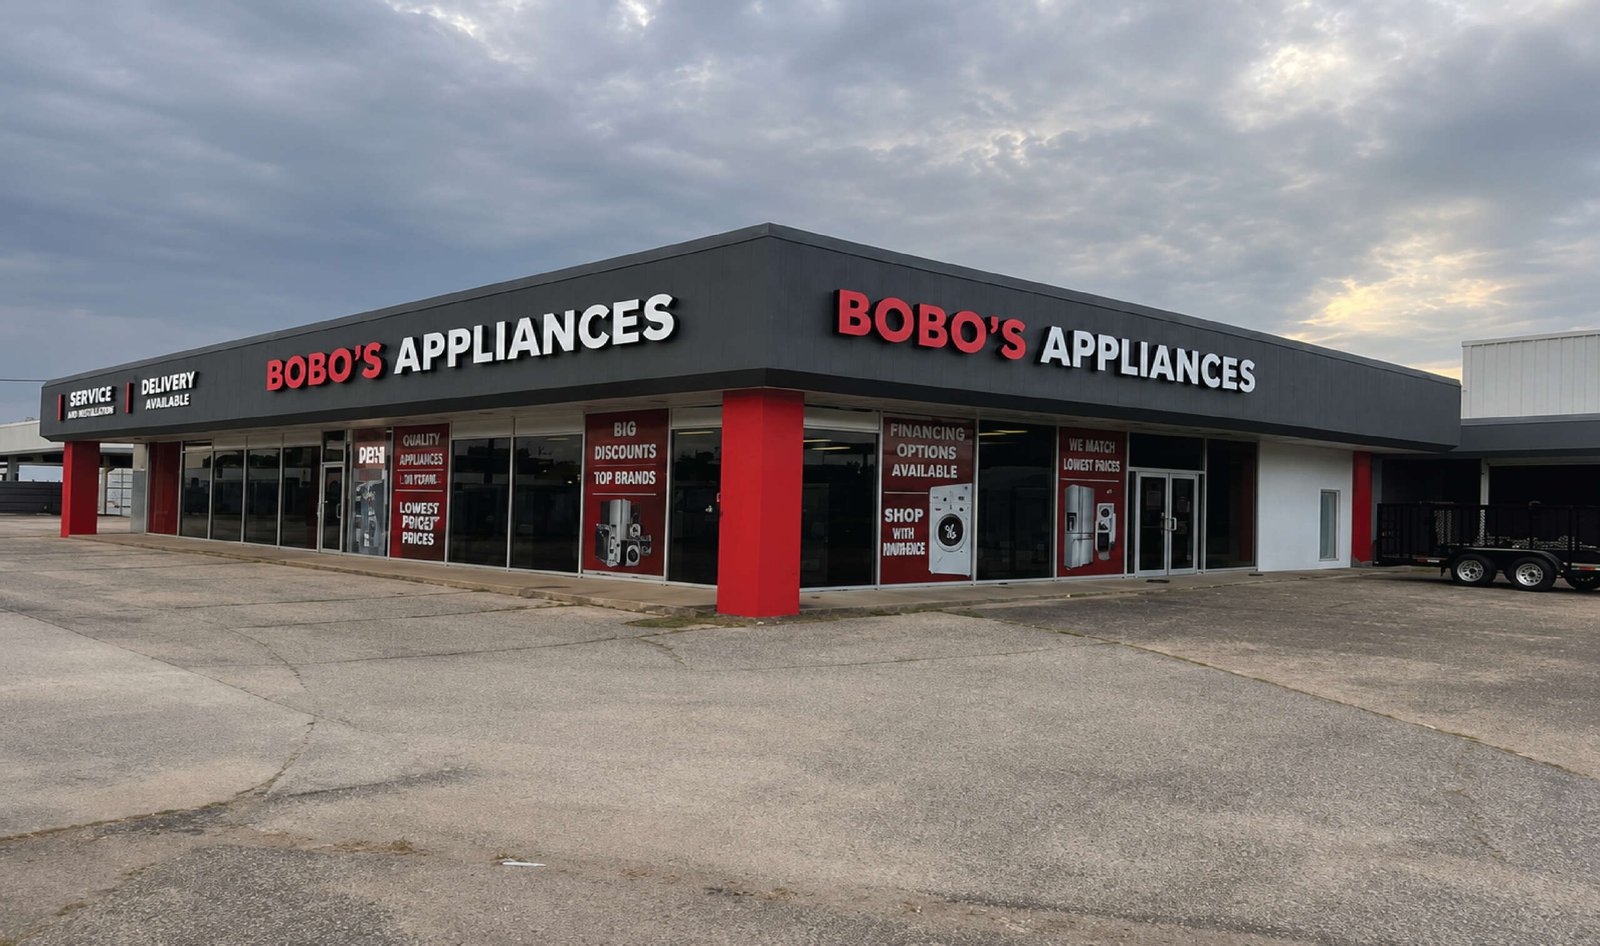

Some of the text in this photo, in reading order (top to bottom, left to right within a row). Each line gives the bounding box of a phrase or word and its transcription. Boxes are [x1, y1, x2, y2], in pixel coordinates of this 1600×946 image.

[266, 293, 675, 392] BOBO'S APPLIANCES
[836, 288, 1256, 394] BOBO'S APPLIANCES
[141, 371, 196, 396] DELIVERY
[69, 386, 113, 407] SERVICE
[145, 393, 190, 410] AVAILABLE
[613, 421, 637, 437] BIG
[890, 423, 965, 442] FINANCING
[402, 433, 441, 447] QUALITY
[1069, 437, 1116, 454] WE MATCH
[399, 453, 444, 466] APPLIANCES
[594, 443, 657, 460] DISCOUNTS
[896, 443, 957, 460] OPTIONS
[892, 463, 958, 479] AVAILABLE
[1063, 457, 1121, 473] LOWEST PRICES
[593, 470, 657, 485] TOP BRANDS
[400, 501, 440, 515] LOWEST
[884, 507, 924, 523] SHOP
[402, 531, 434, 546] PRICES
[892, 527, 915, 540] WITH
